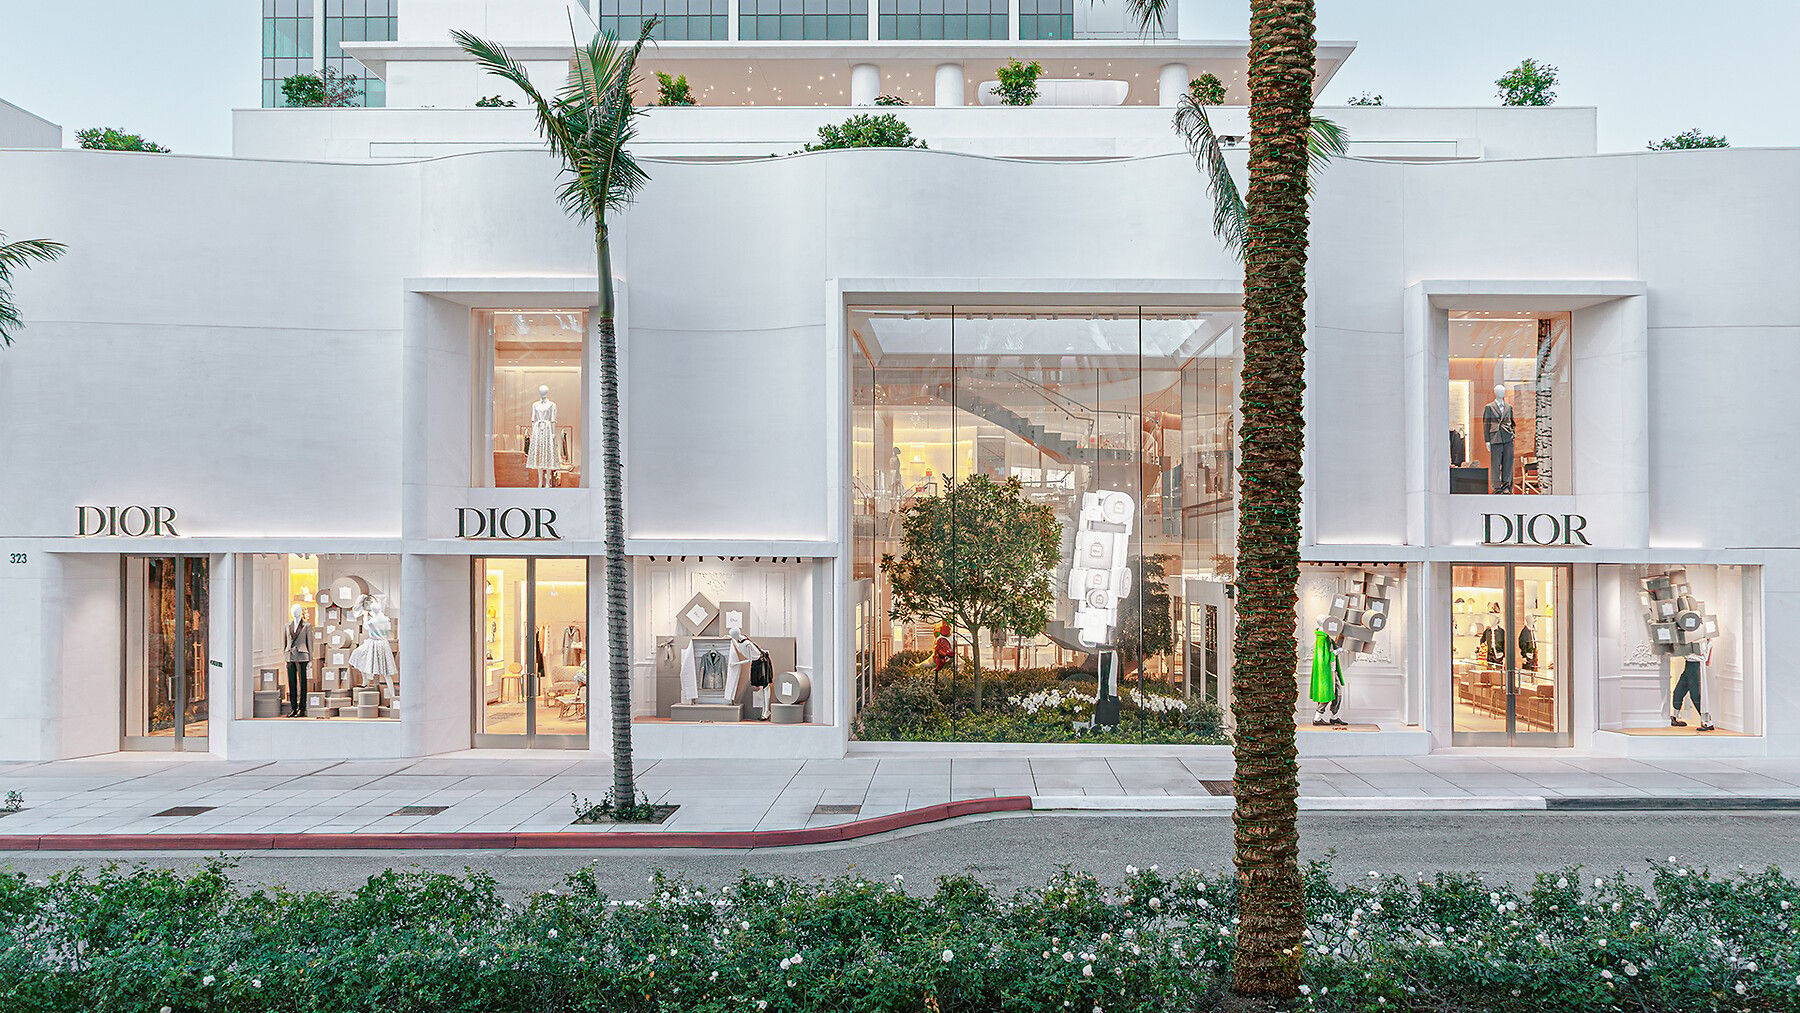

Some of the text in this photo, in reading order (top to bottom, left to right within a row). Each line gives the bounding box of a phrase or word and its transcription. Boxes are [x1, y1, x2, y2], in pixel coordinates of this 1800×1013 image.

[75, 505, 180, 536] DIOR
[454, 507, 562, 539] DIOR
[1480, 513, 1593, 545] DIOR
[9, 553, 27, 564] 323
